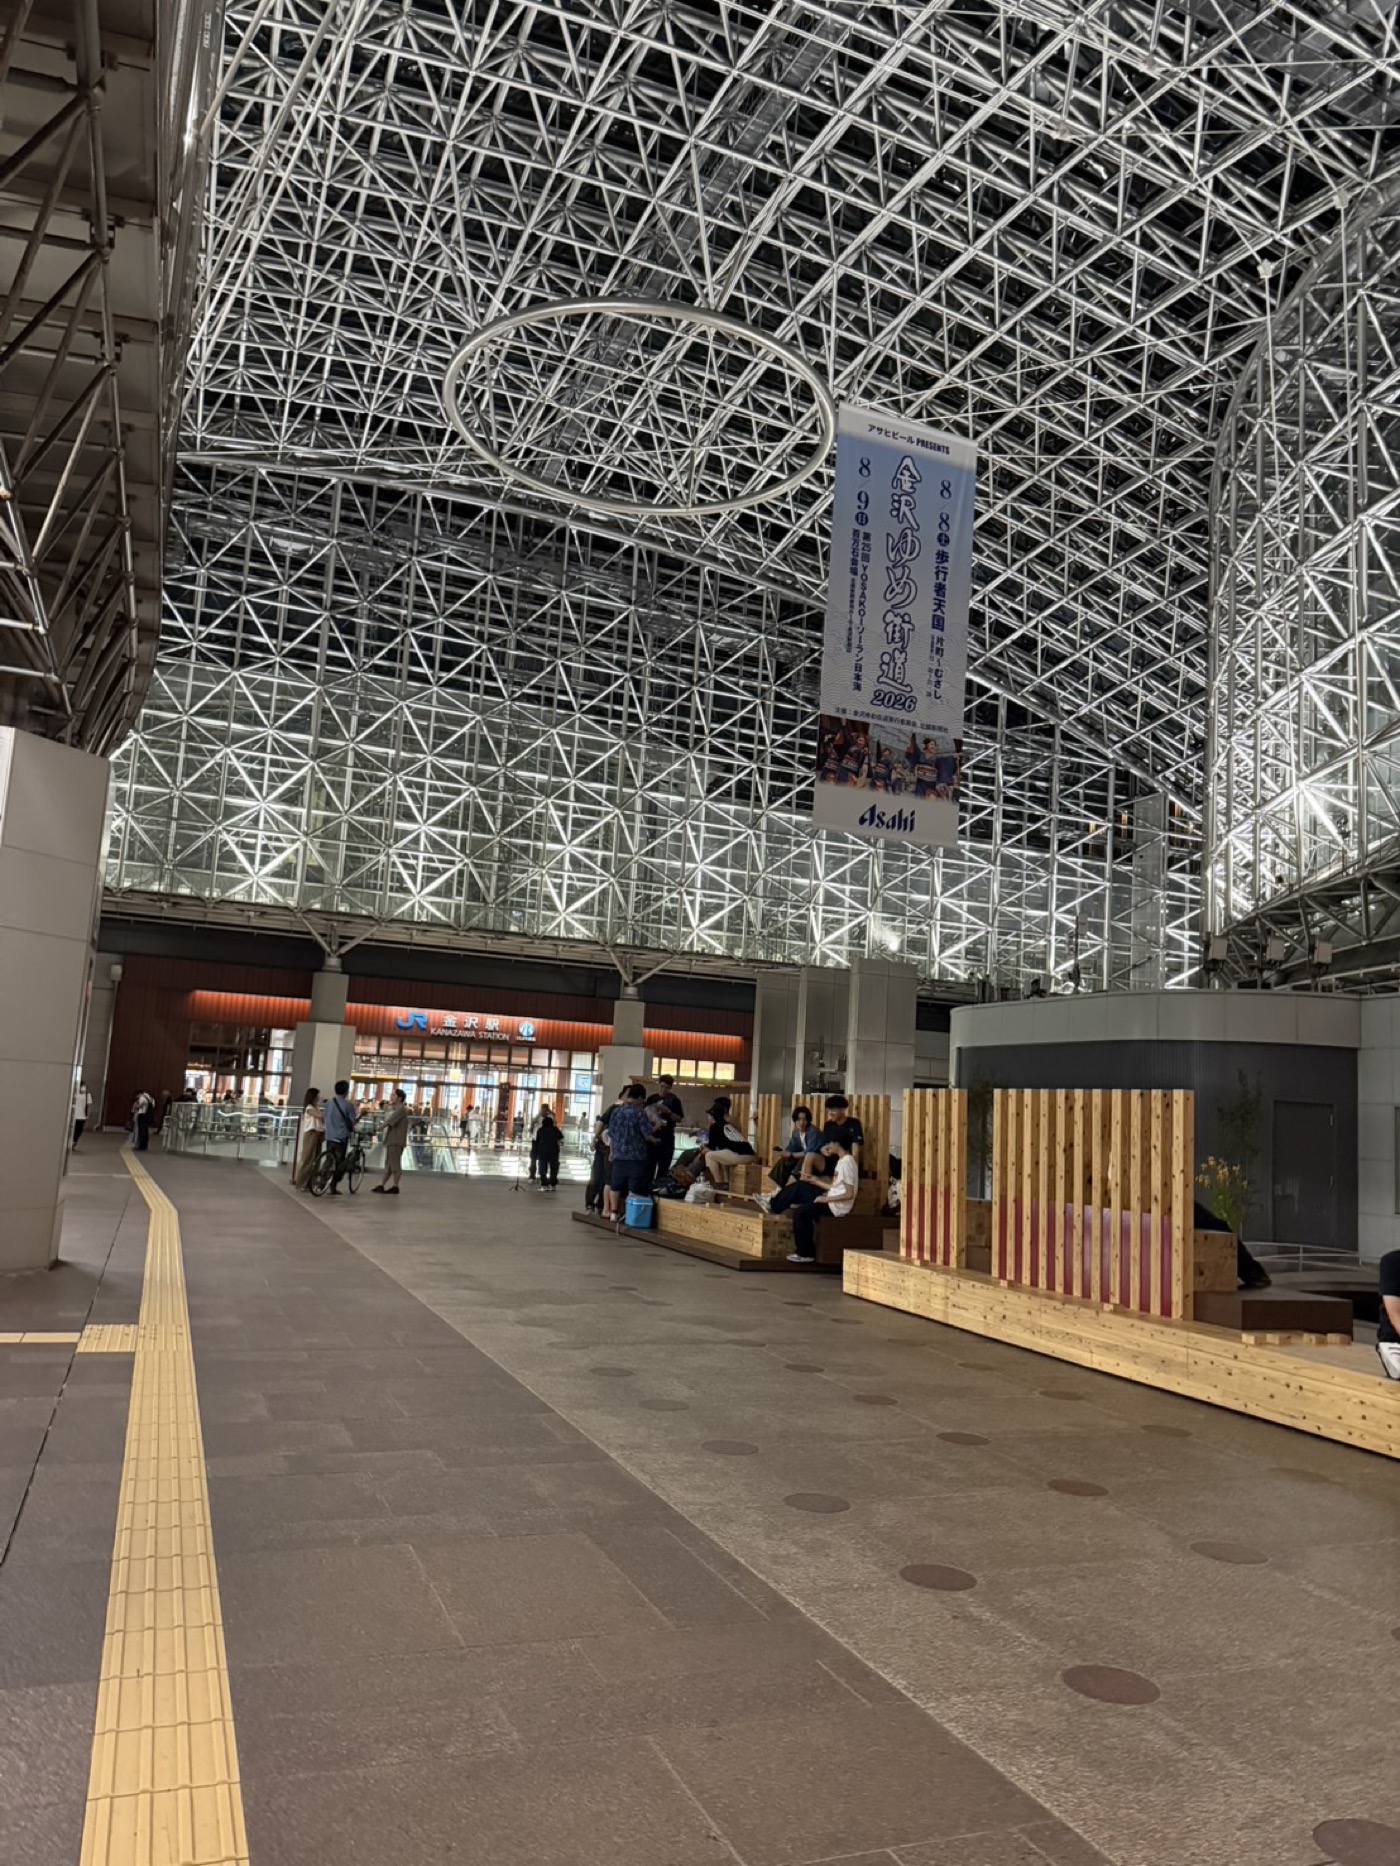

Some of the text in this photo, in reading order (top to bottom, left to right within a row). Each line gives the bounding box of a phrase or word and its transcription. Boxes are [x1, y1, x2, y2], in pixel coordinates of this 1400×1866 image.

[868, 424, 950, 455] アサヒビール PRESENTS
[877, 455, 921, 692] 金沢ゆめ街道
[931, 550, 949, 632] 歩行者天国
[871, 689, 917, 712] 2026
[858, 804, 915, 832] Asahi
[397, 1012, 428, 1031] JR
[430, 1027, 476, 1038] KANAZAWA
[479, 1032, 510, 1041] STATION
[443, 1014, 500, 1031] 金沢駅
